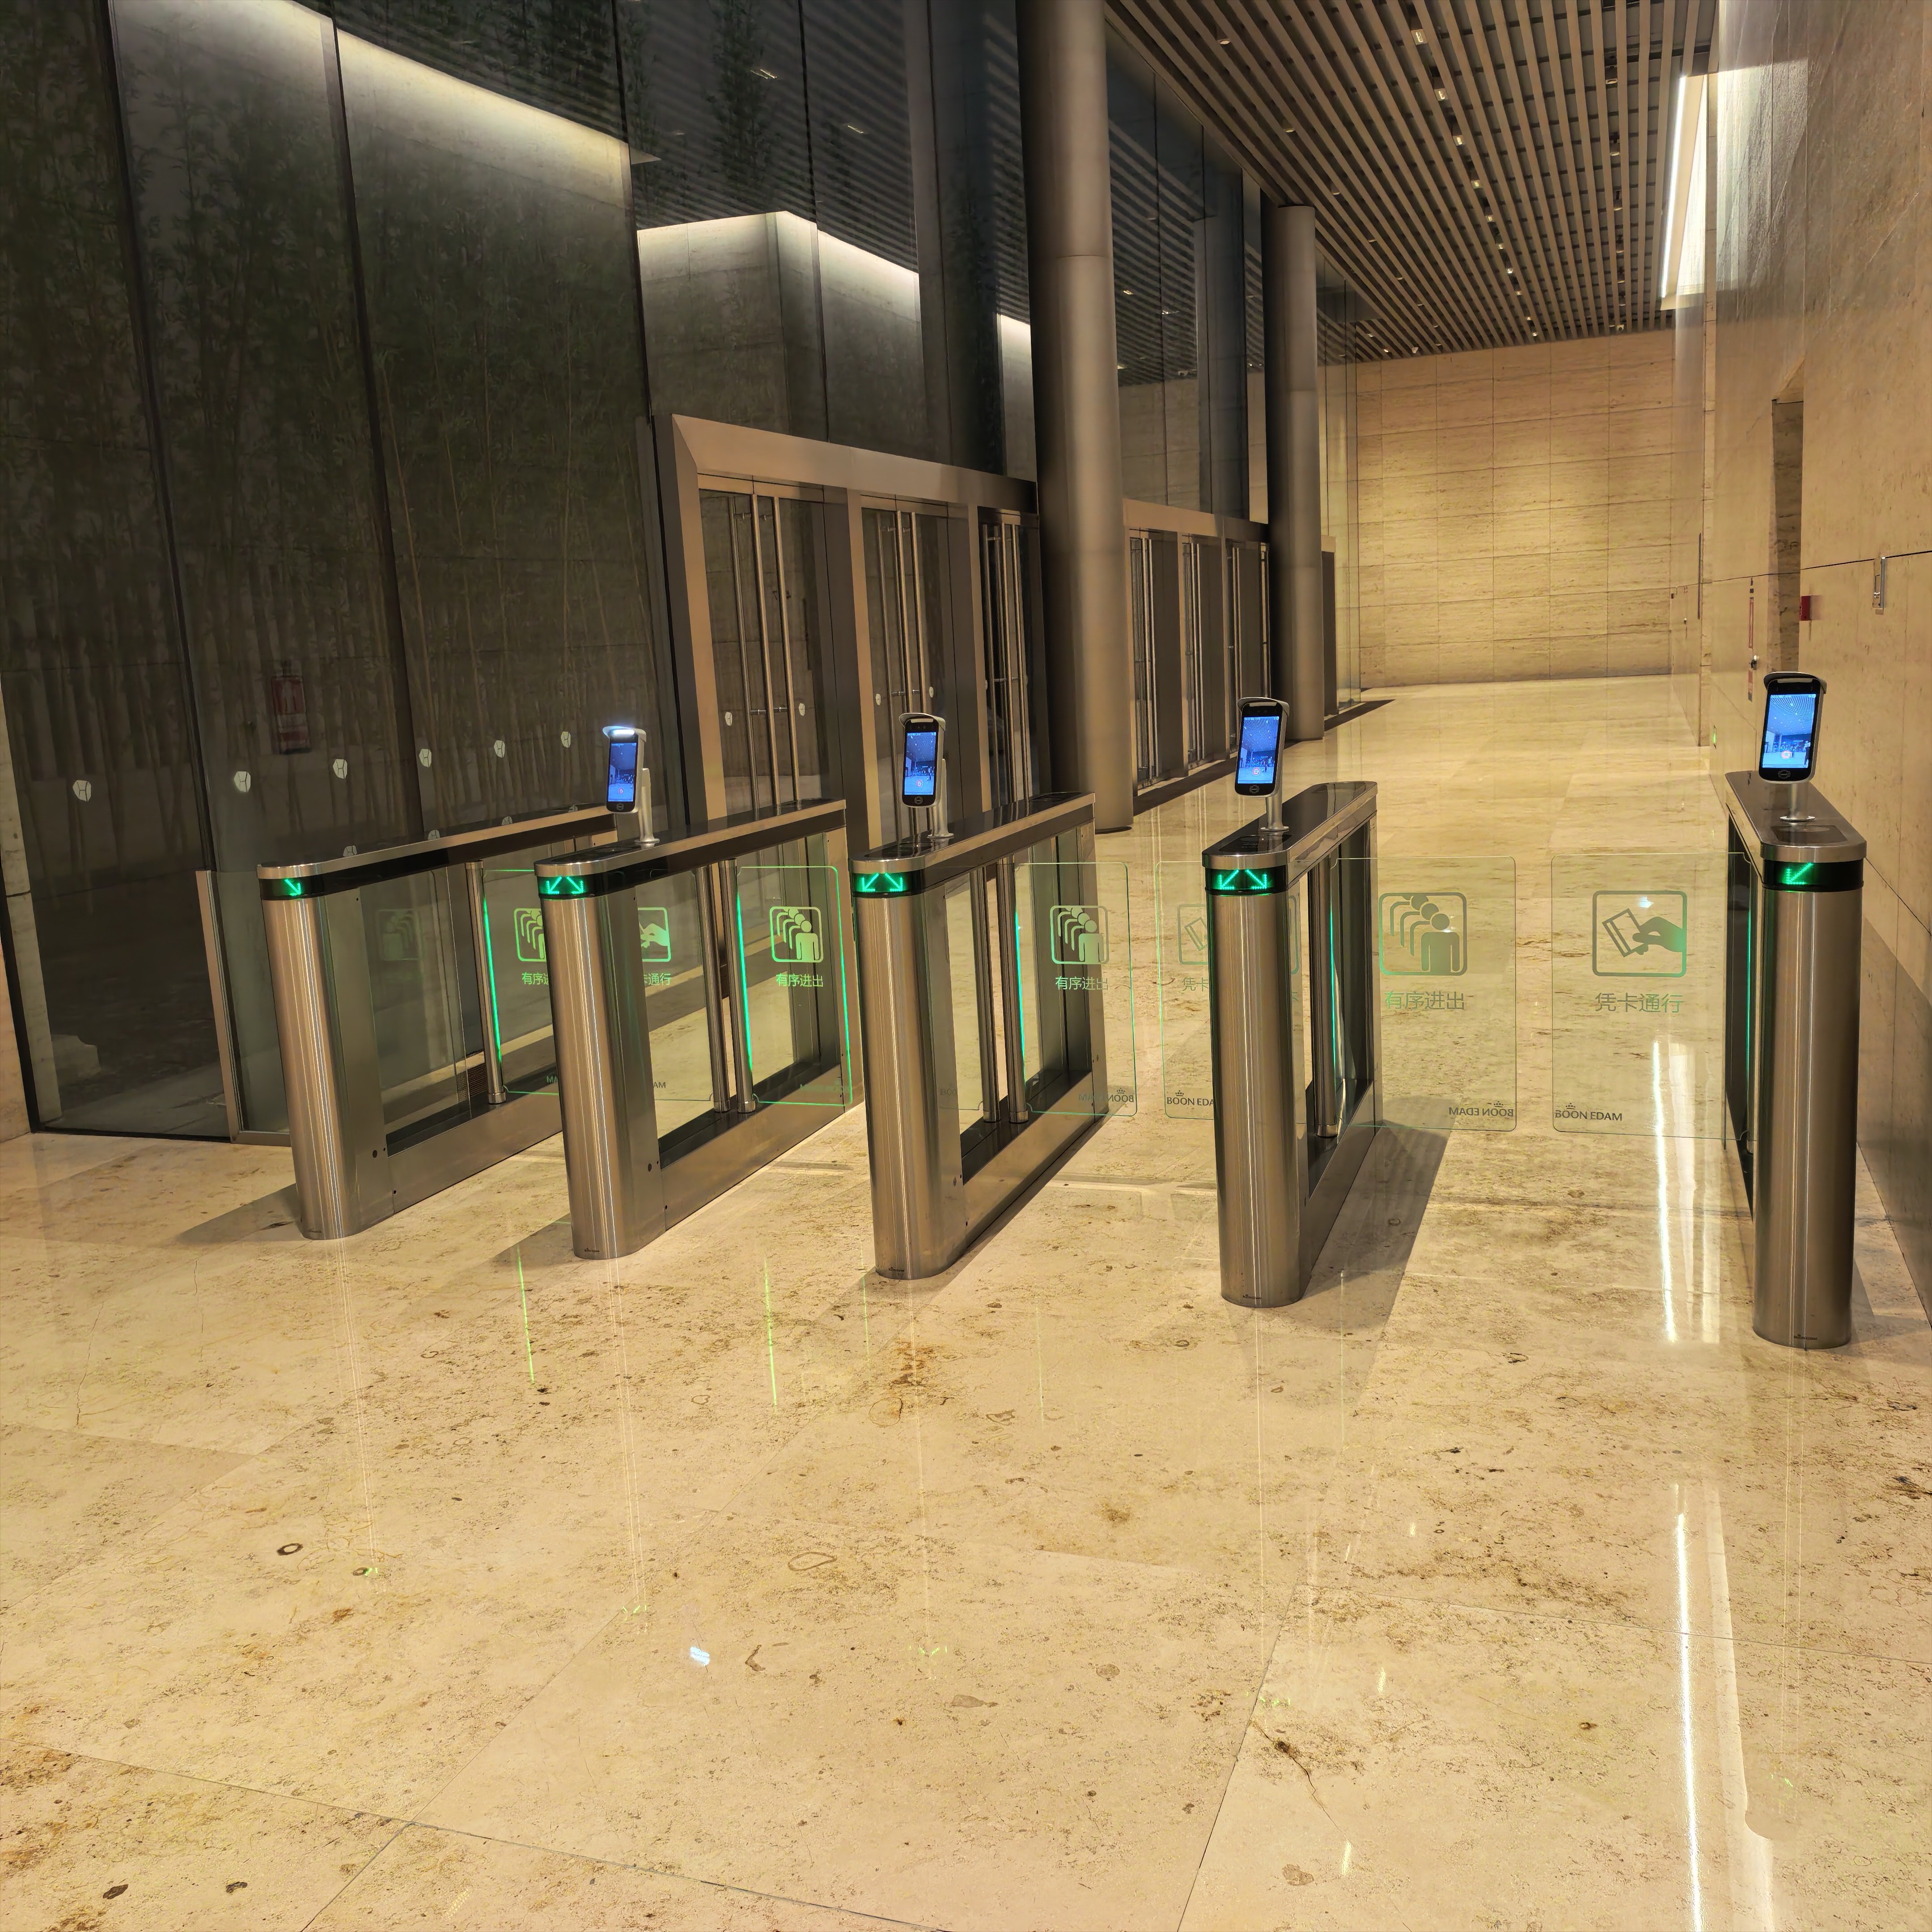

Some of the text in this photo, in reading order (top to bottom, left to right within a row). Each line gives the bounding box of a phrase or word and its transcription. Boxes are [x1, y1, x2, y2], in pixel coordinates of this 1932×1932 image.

[776, 973, 823, 987] 有序进出
[1055, 976, 1108, 990] 有序进出
[1385, 991, 1465, 1009] 有序进出
[1595, 992, 1683, 1013] 凭卡通行
[1167, 1097, 1195, 1105] BOON
[1555, 1110, 1623, 1121] BOON EDAM
